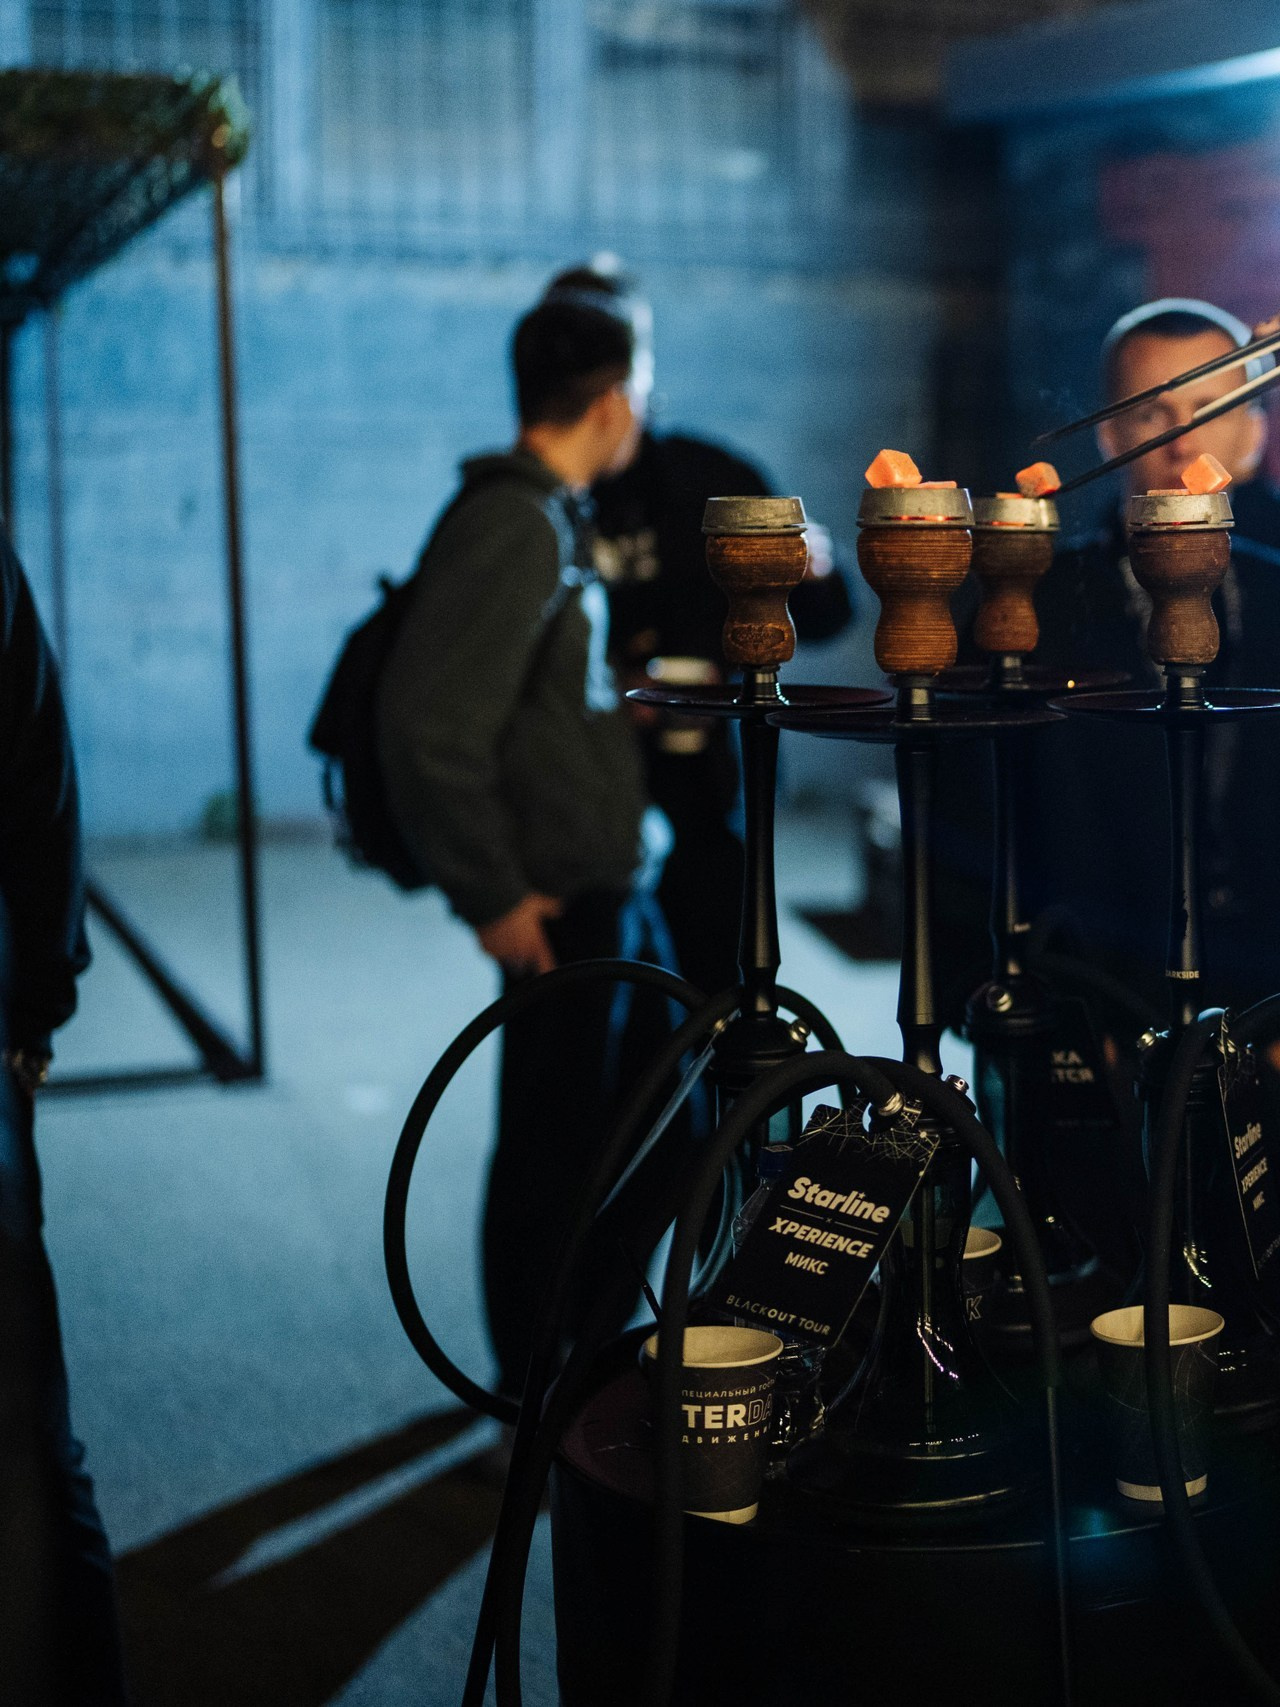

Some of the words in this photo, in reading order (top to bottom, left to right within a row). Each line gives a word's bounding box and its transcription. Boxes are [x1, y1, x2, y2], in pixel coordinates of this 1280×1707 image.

[787, 1176, 891, 1224] Starline
[768, 1217, 875, 1259] XPERIENCE
[784, 1251, 830, 1276] МИКС
[725, 1294, 797, 1324] BLACKOUT
[798, 1315, 832, 1337] TOUR
[681, 1385, 757, 1398] ПЕЦИАЛЬНЫЙ
